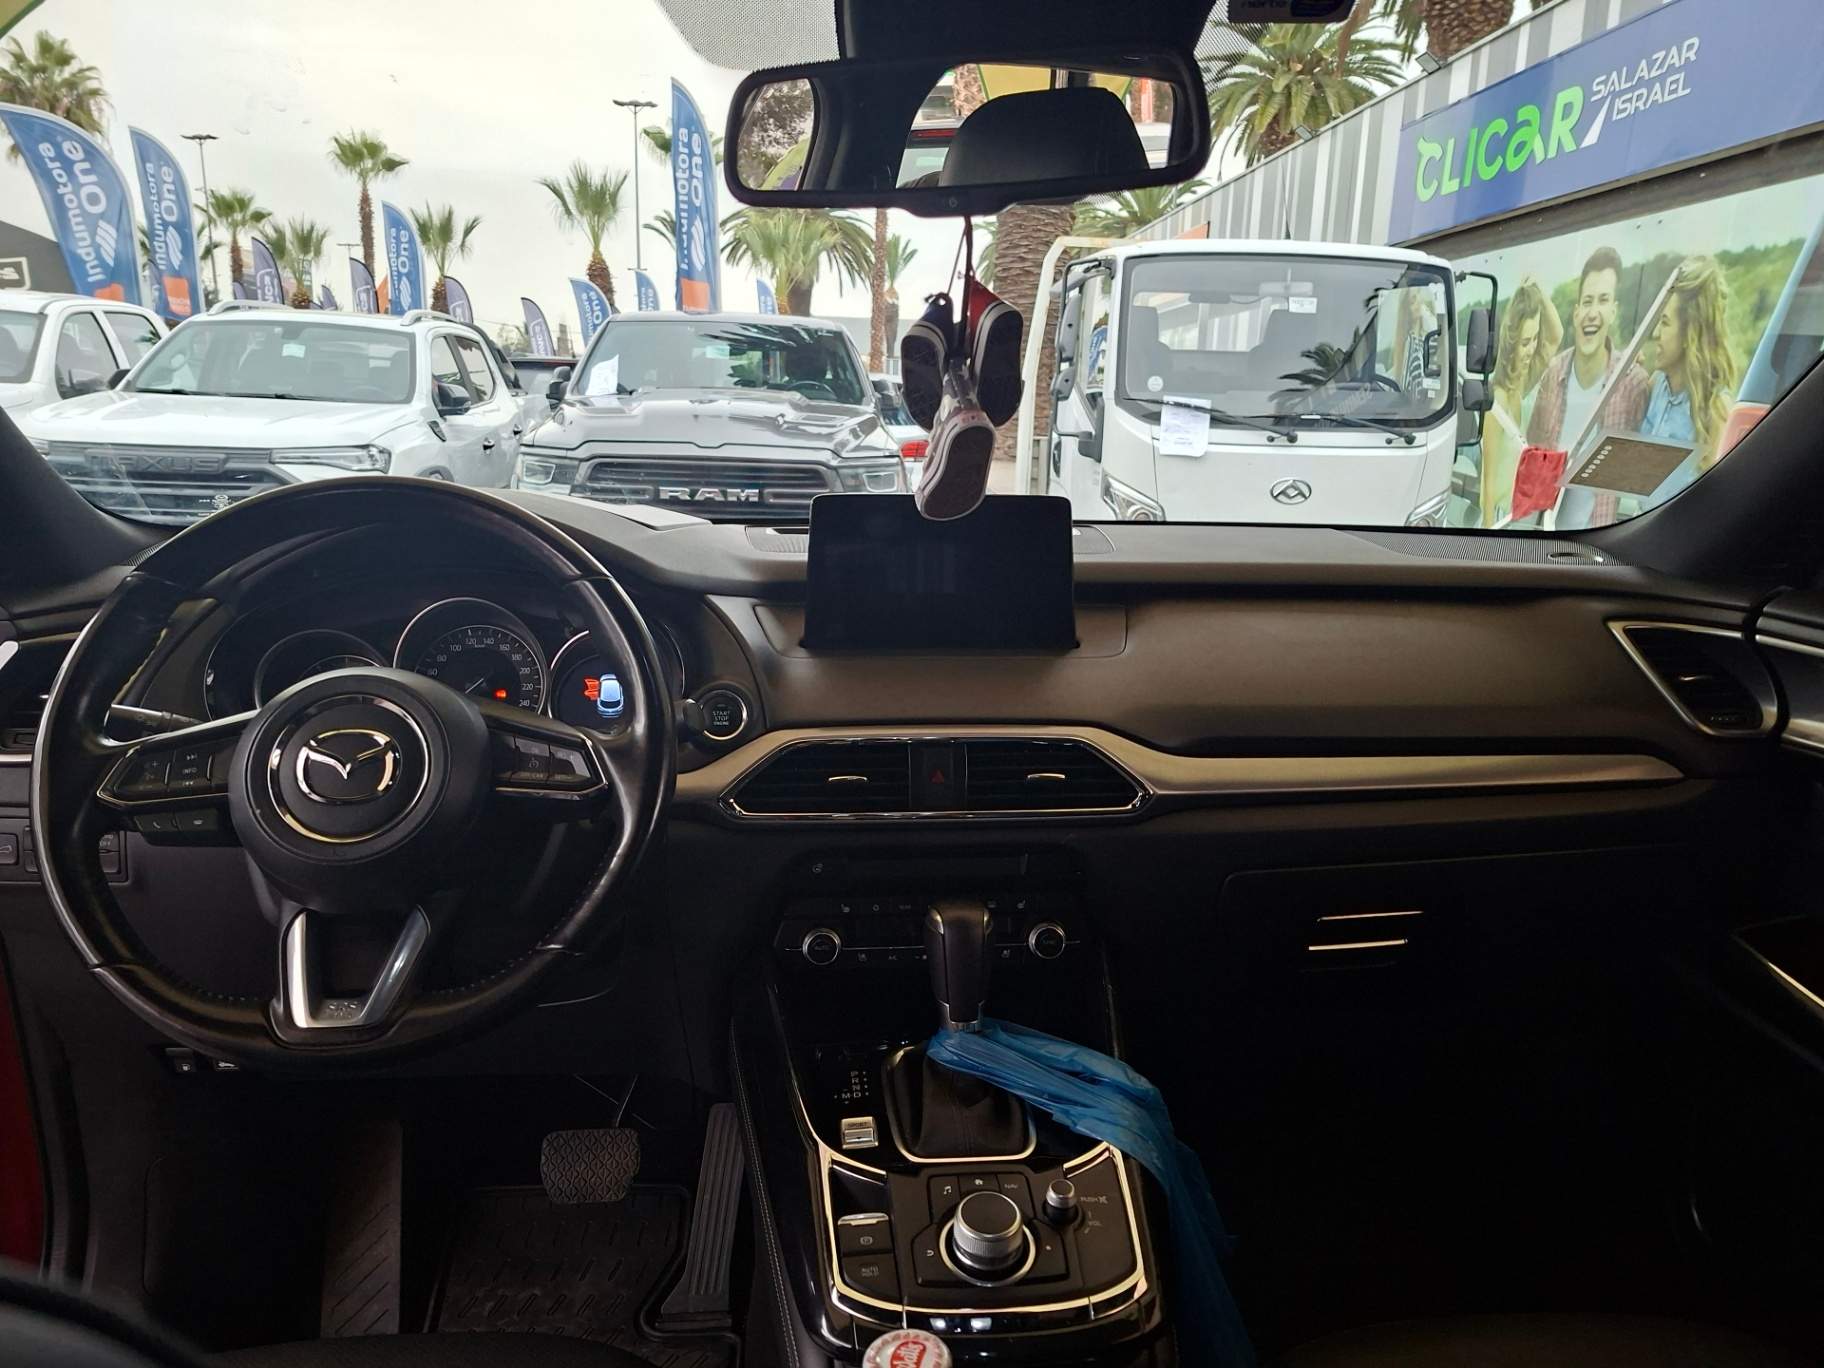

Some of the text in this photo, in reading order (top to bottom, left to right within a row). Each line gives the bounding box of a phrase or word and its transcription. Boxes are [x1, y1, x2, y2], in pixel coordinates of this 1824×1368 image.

[1591, 36, 1700, 102] SALAZAR
[1611, 71, 1693, 122] ISRAEL
[63, 139, 107, 215] One
[161, 165, 178, 223] One
[690, 132, 704, 207] One
[38, 141, 107, 283] Indumotora
[398, 230, 409, 274] One
[659, 487, 760, 503] RAM
[522, 683, 533, 691] 220
